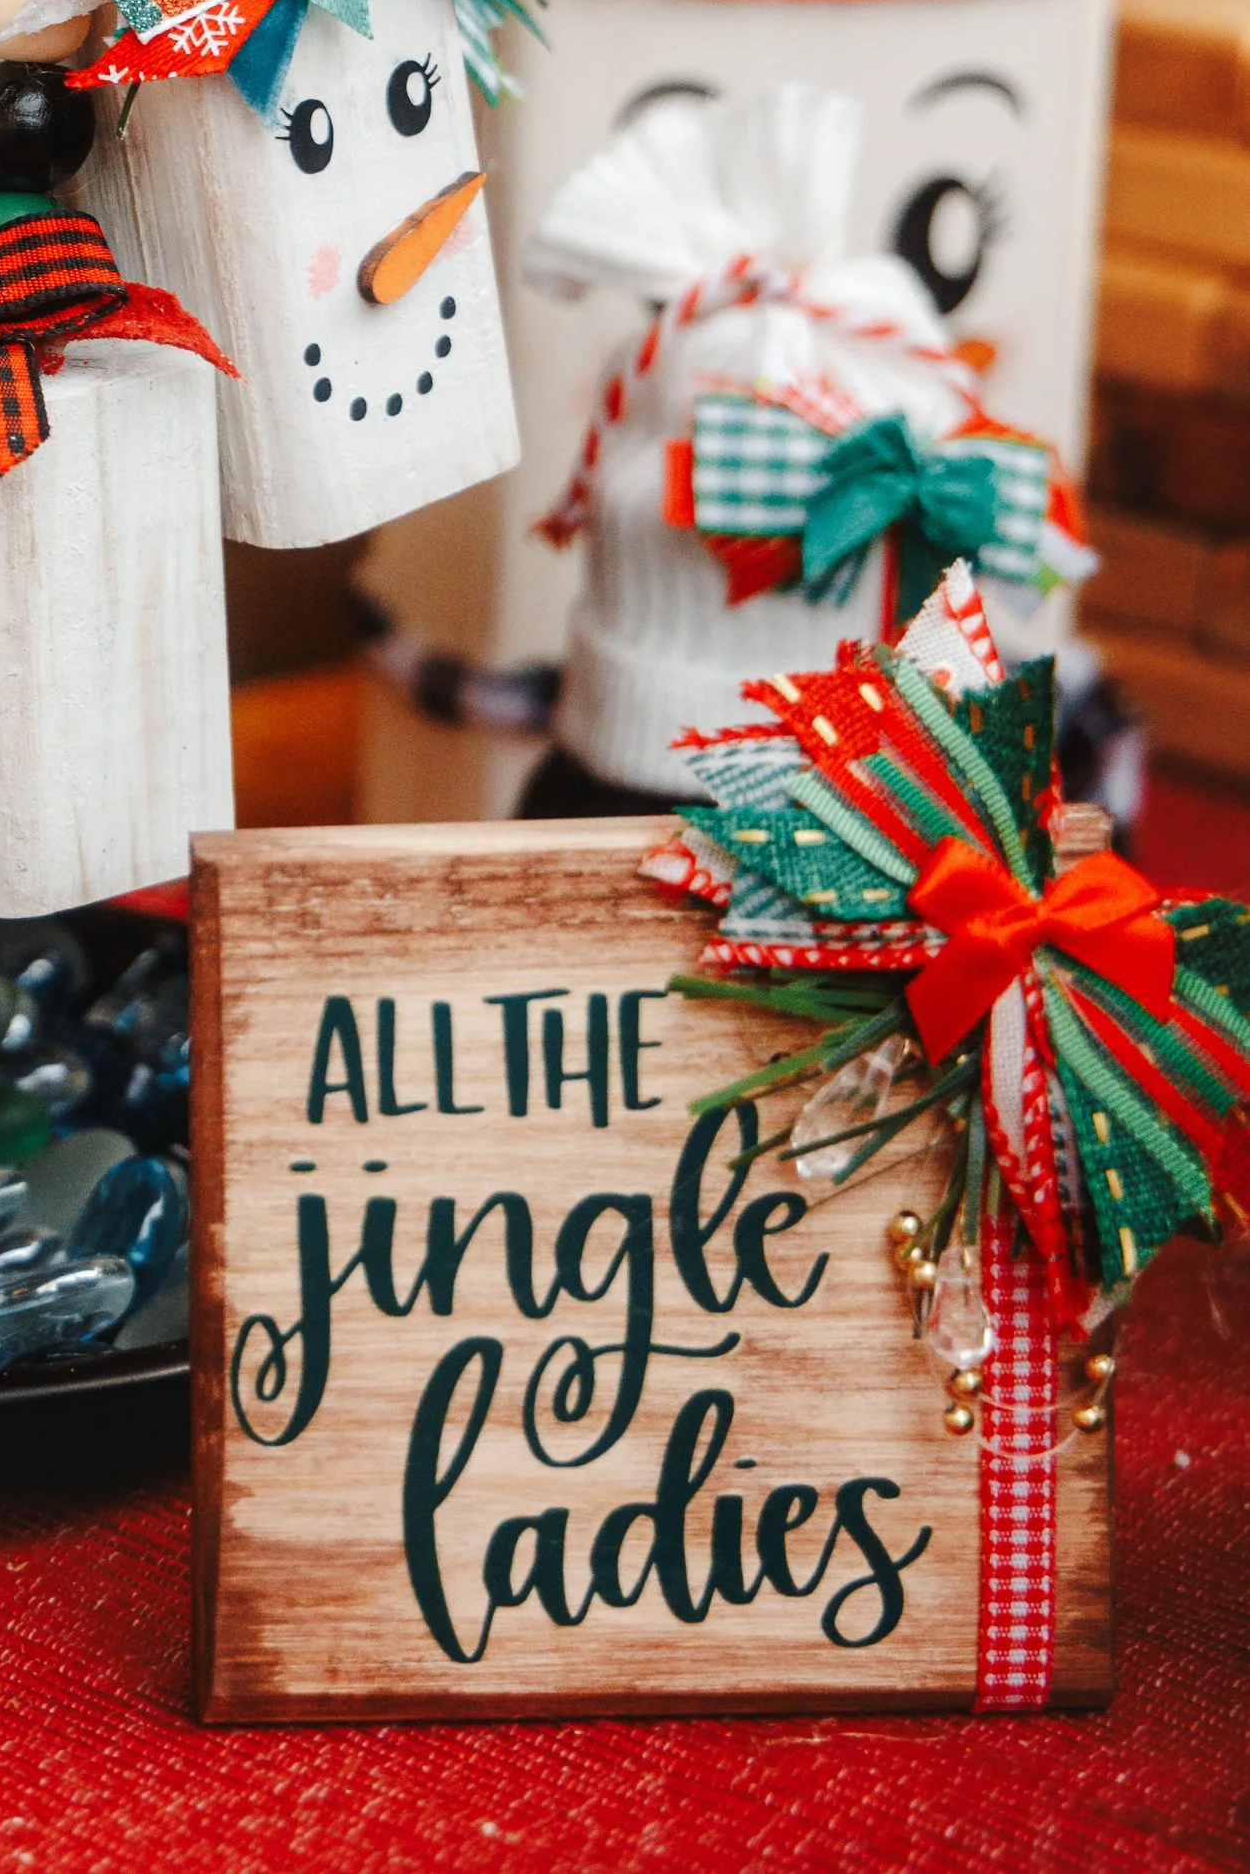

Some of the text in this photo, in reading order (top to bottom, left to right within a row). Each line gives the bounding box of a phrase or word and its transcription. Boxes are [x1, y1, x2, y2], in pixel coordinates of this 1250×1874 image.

[307, 988, 670, 1129] ALL THE
[230, 1100, 831, 1468] jingle
[401, 1335, 933, 1664] ladies
